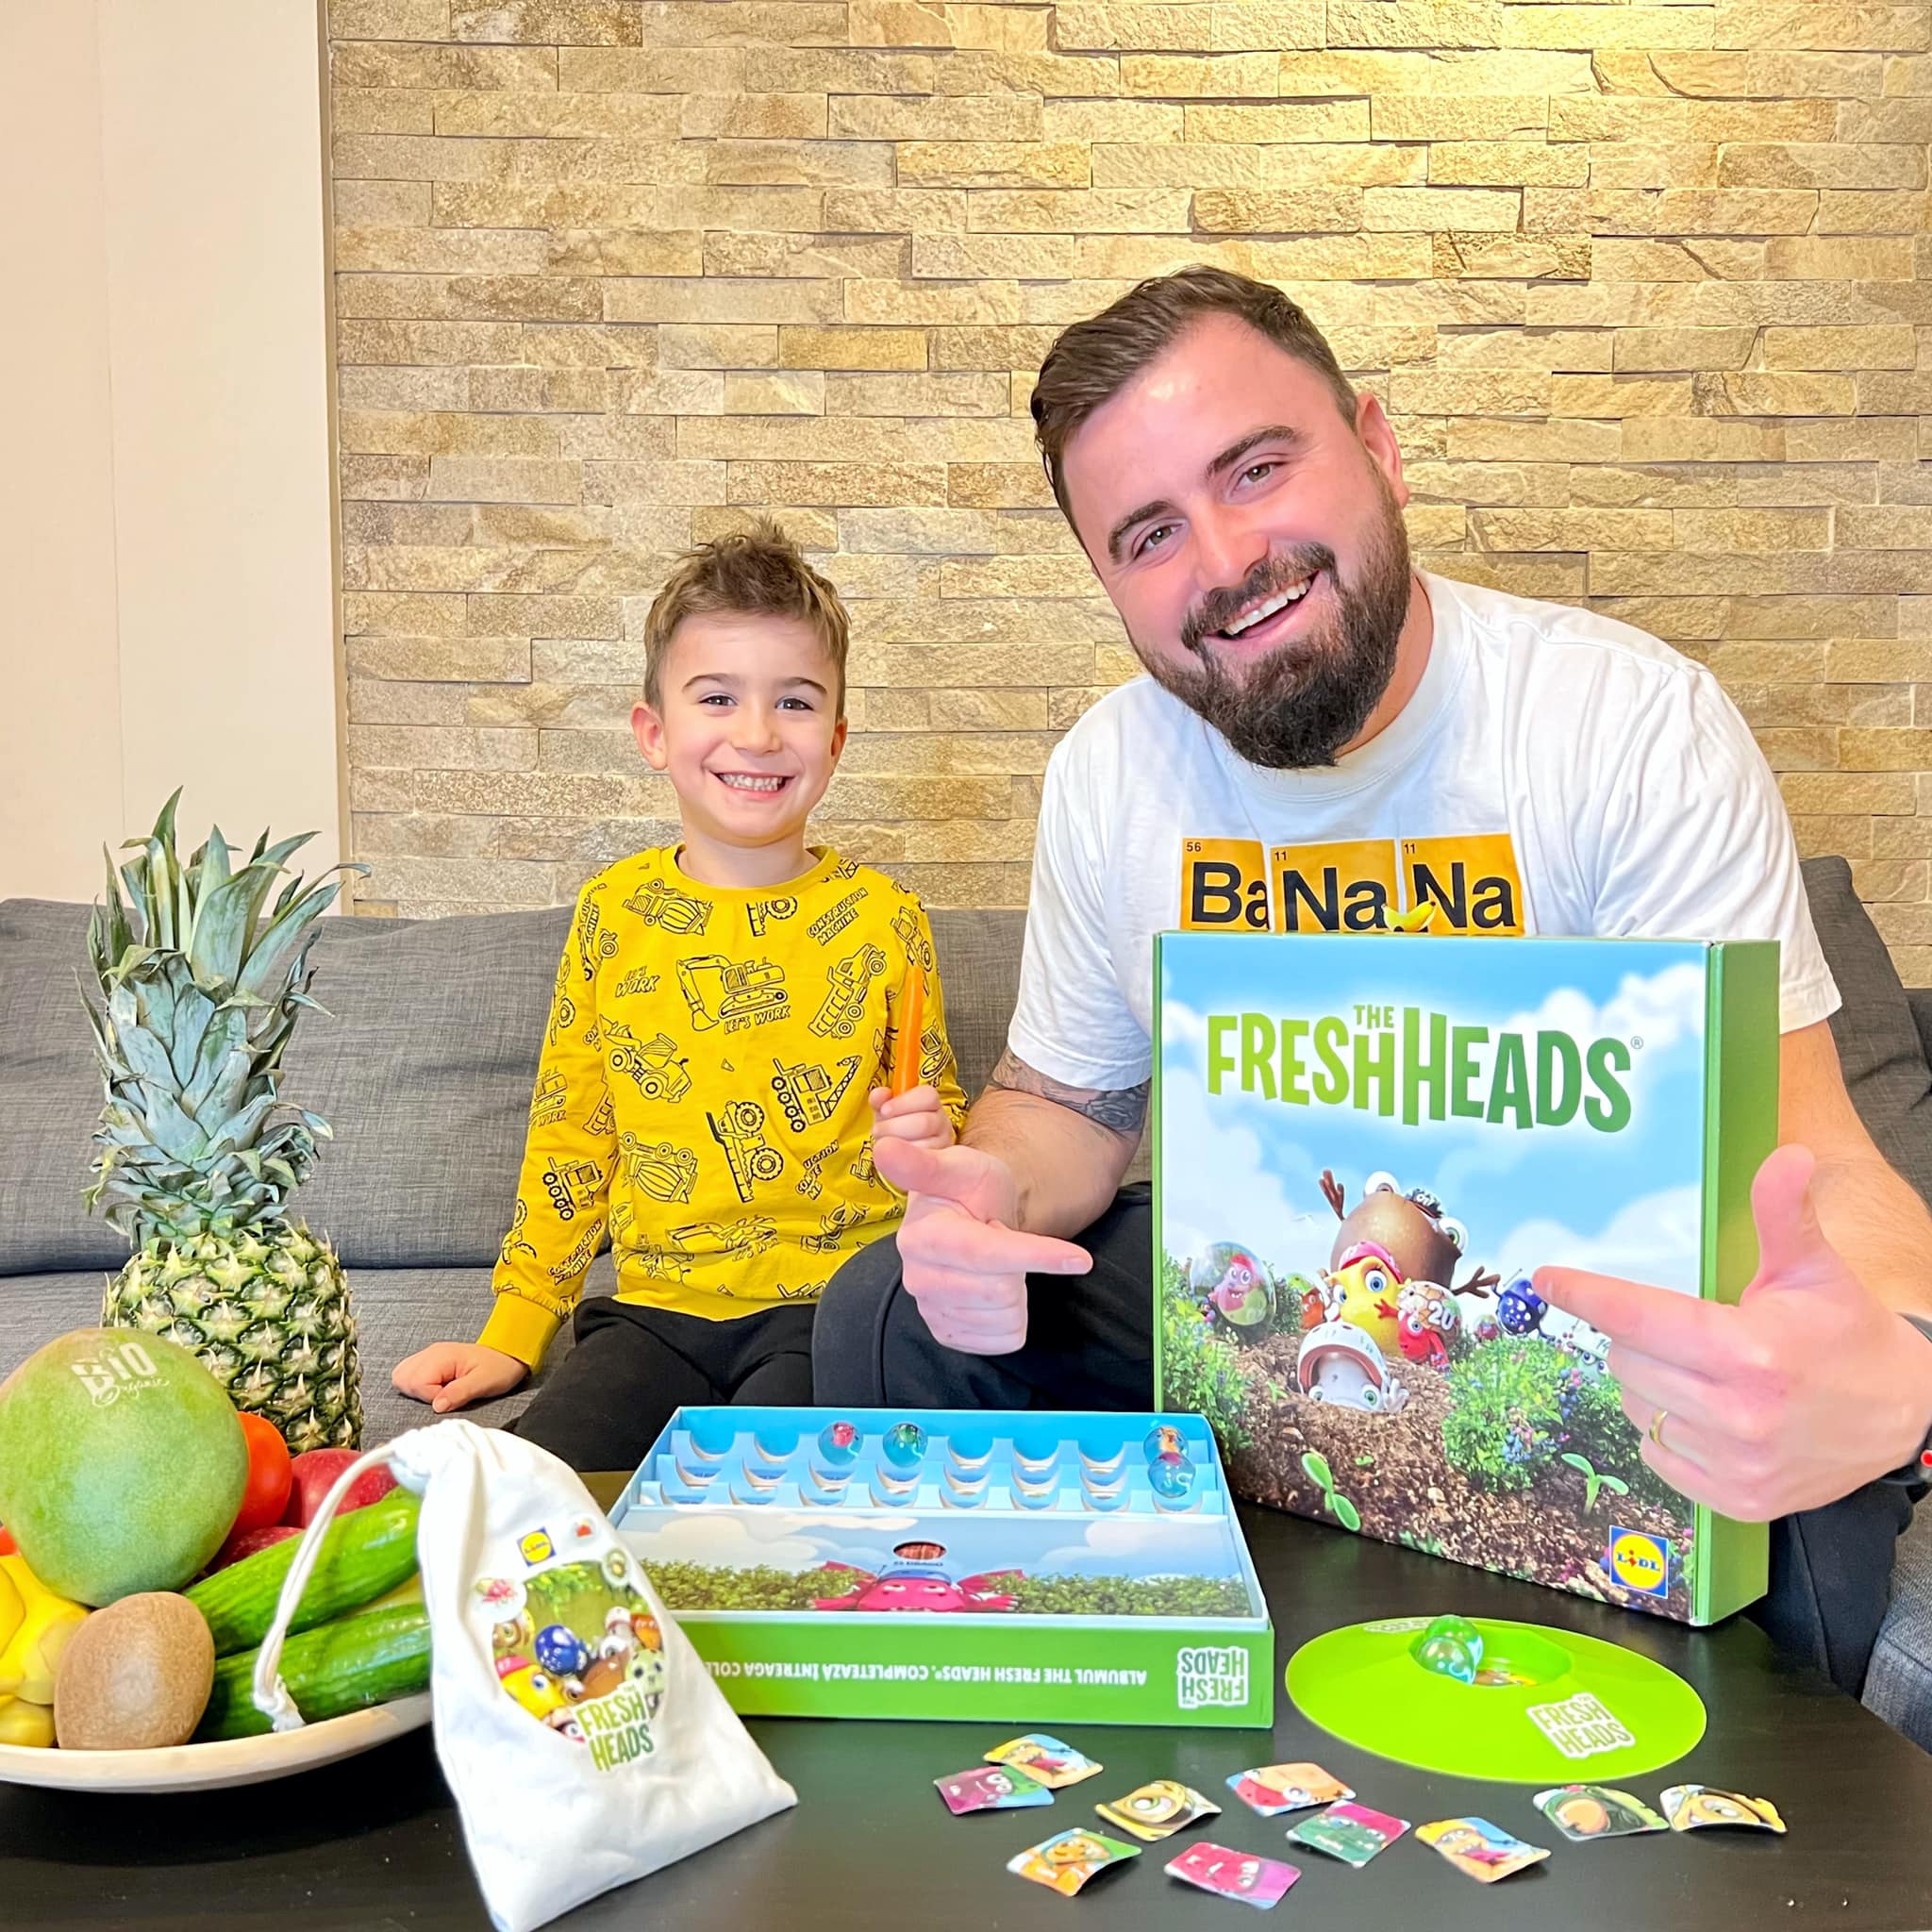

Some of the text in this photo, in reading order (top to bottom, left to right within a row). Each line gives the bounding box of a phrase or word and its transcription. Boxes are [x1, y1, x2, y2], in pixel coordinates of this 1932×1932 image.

[1186, 841, 1416, 861] 56 11 11
[1191, 861, 1516, 932] Ba Na Na
[807, 887, 868, 939] CONSTRUCTION
[817, 908, 859, 946] MACHINE
[615, 975, 660, 998] WORK
[724, 1005, 791, 1035] LET'S WORK
[1353, 1005, 1394, 1029] THE
[1208, 1012, 1395, 1117] FRESH
[994, 1666, 1041, 1683] FRESH
[1043, 1667, 1073, 1684] THE
[1077, 1668, 1148, 1686] ALBUMUL
[1181, 1650, 1244, 1677] HEADS
[1182, 1676, 1244, 1702] FRESH
[576, 1691, 646, 1737] FRESH
[1532, 1701, 1611, 1730] FRESH
[589, 1724, 654, 1772] HEADS
[1551, 1723, 1631, 1754] HEADS
